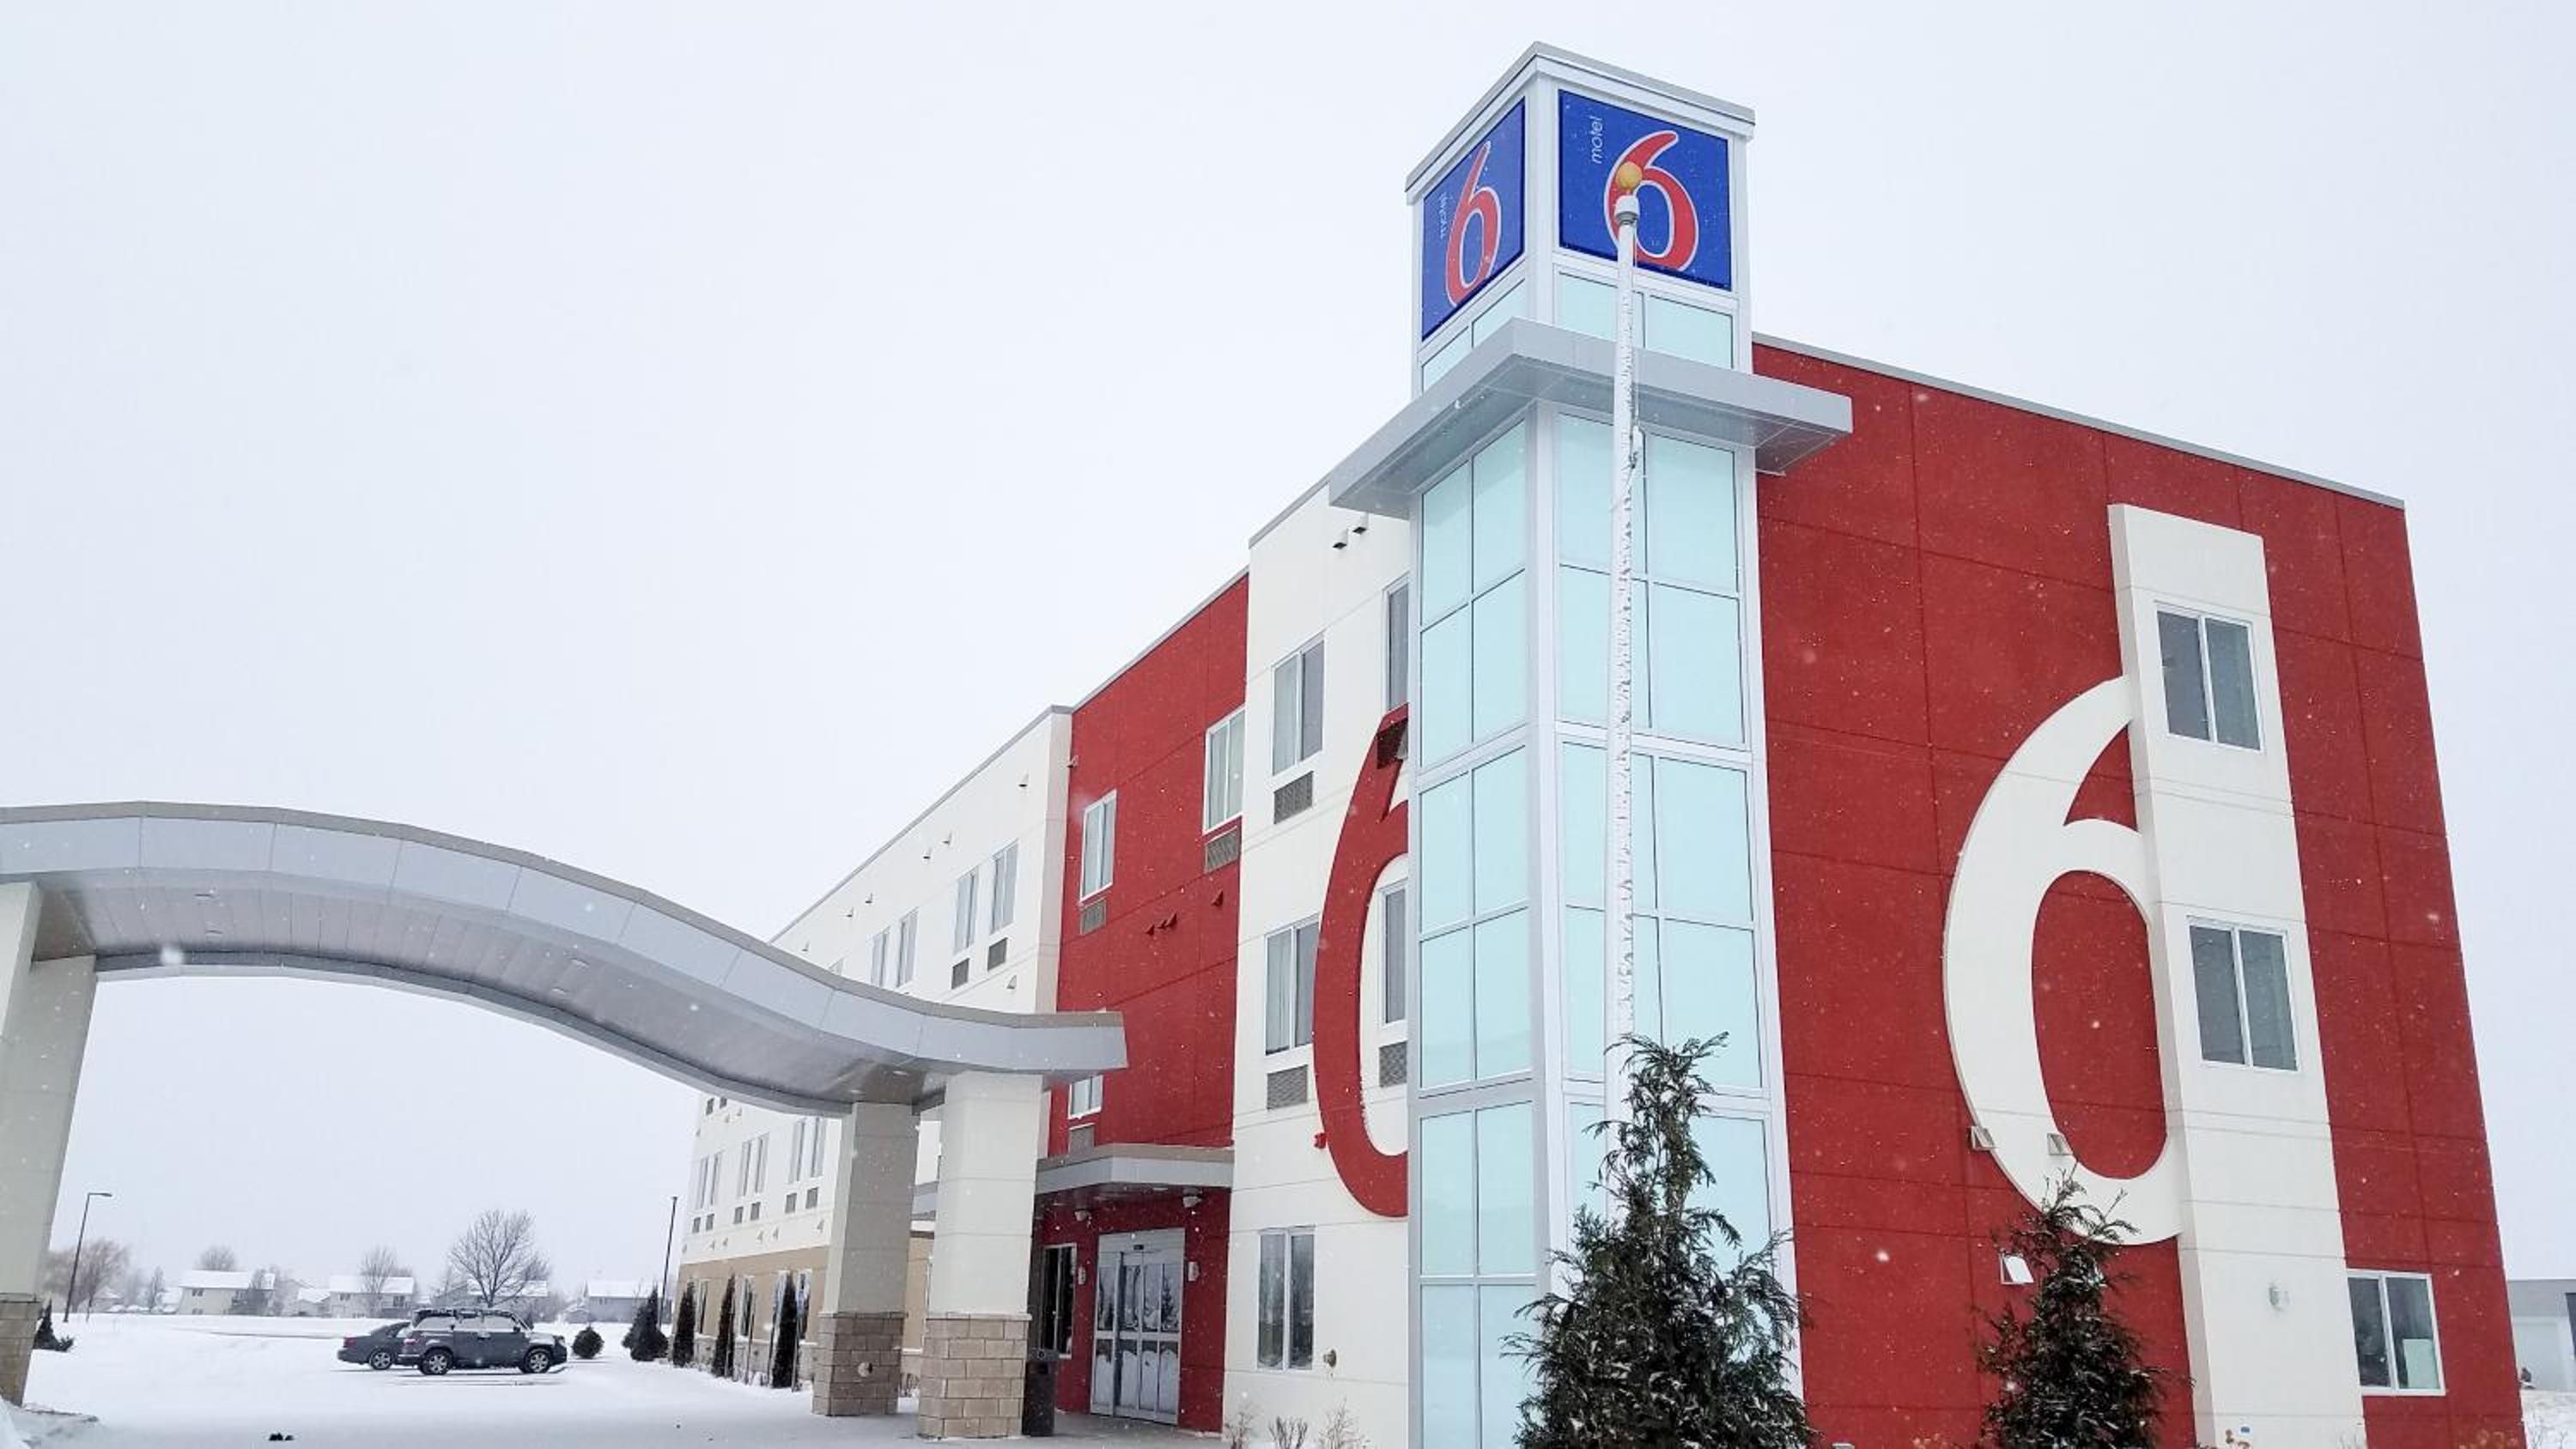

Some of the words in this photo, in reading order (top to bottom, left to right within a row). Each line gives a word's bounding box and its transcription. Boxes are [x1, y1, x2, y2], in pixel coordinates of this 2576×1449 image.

[1590, 116, 1604, 164] motel
[1604, 130, 1699, 271] 6
[1445, 140, 1502, 308] 6
[1942, 675, 2183, 1246] 6
